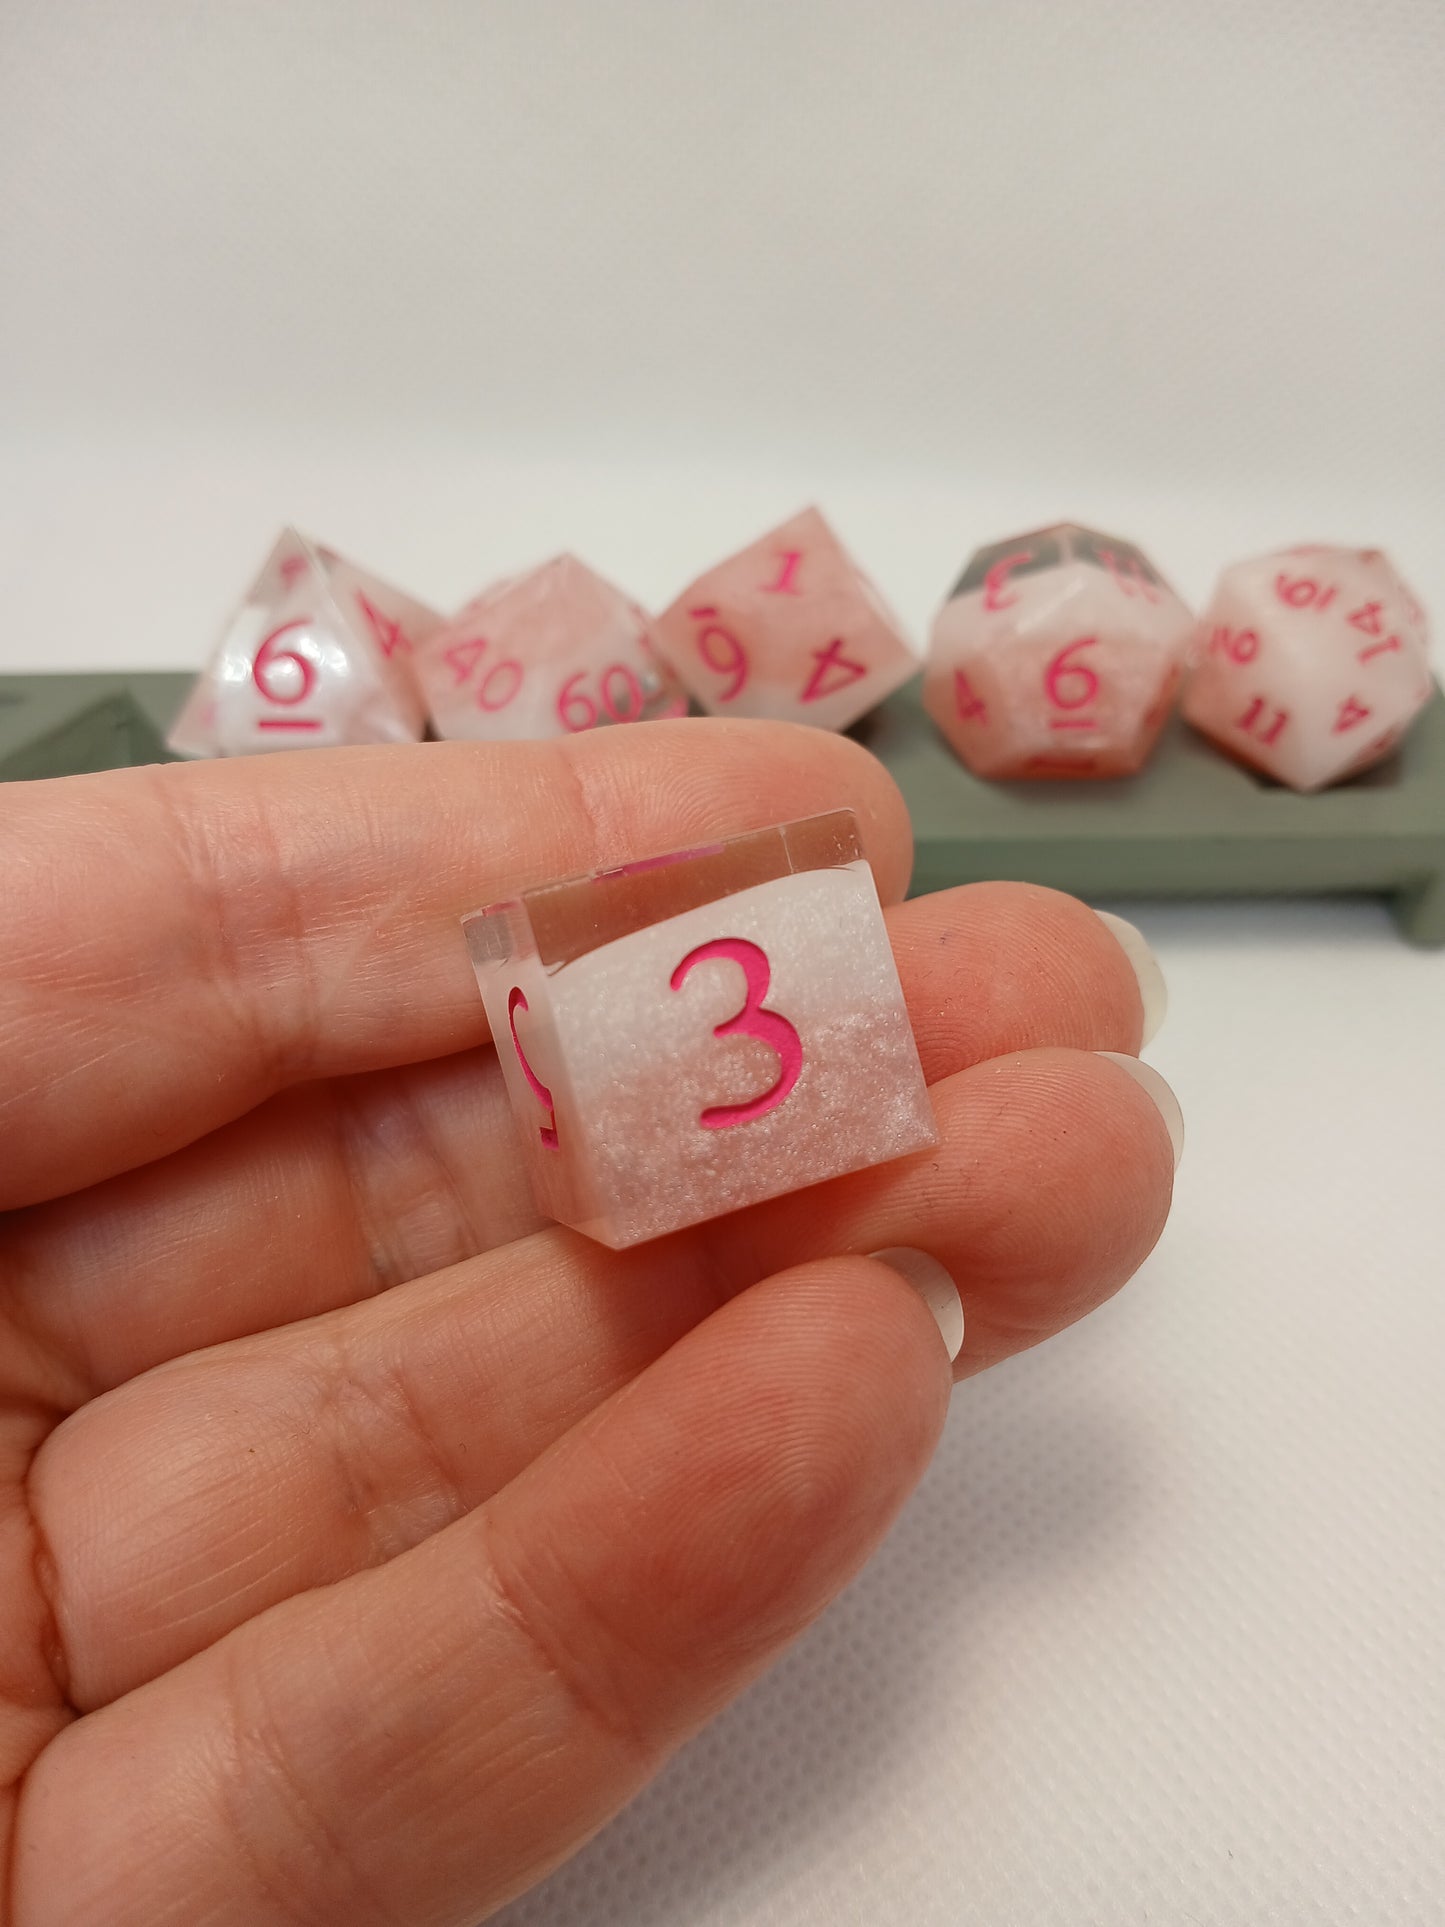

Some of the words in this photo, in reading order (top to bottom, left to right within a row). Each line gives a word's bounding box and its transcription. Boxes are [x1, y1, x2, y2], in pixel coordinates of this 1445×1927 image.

[757, 551, 803, 595] 1
[253, 618, 324, 731] 6
[443, 637, 525, 712] 40
[557, 664, 643, 733] 60
[798, 637, 866, 704] 4
[1044, 638, 1099, 730] 6
[670, 937, 802, 1129] 3
